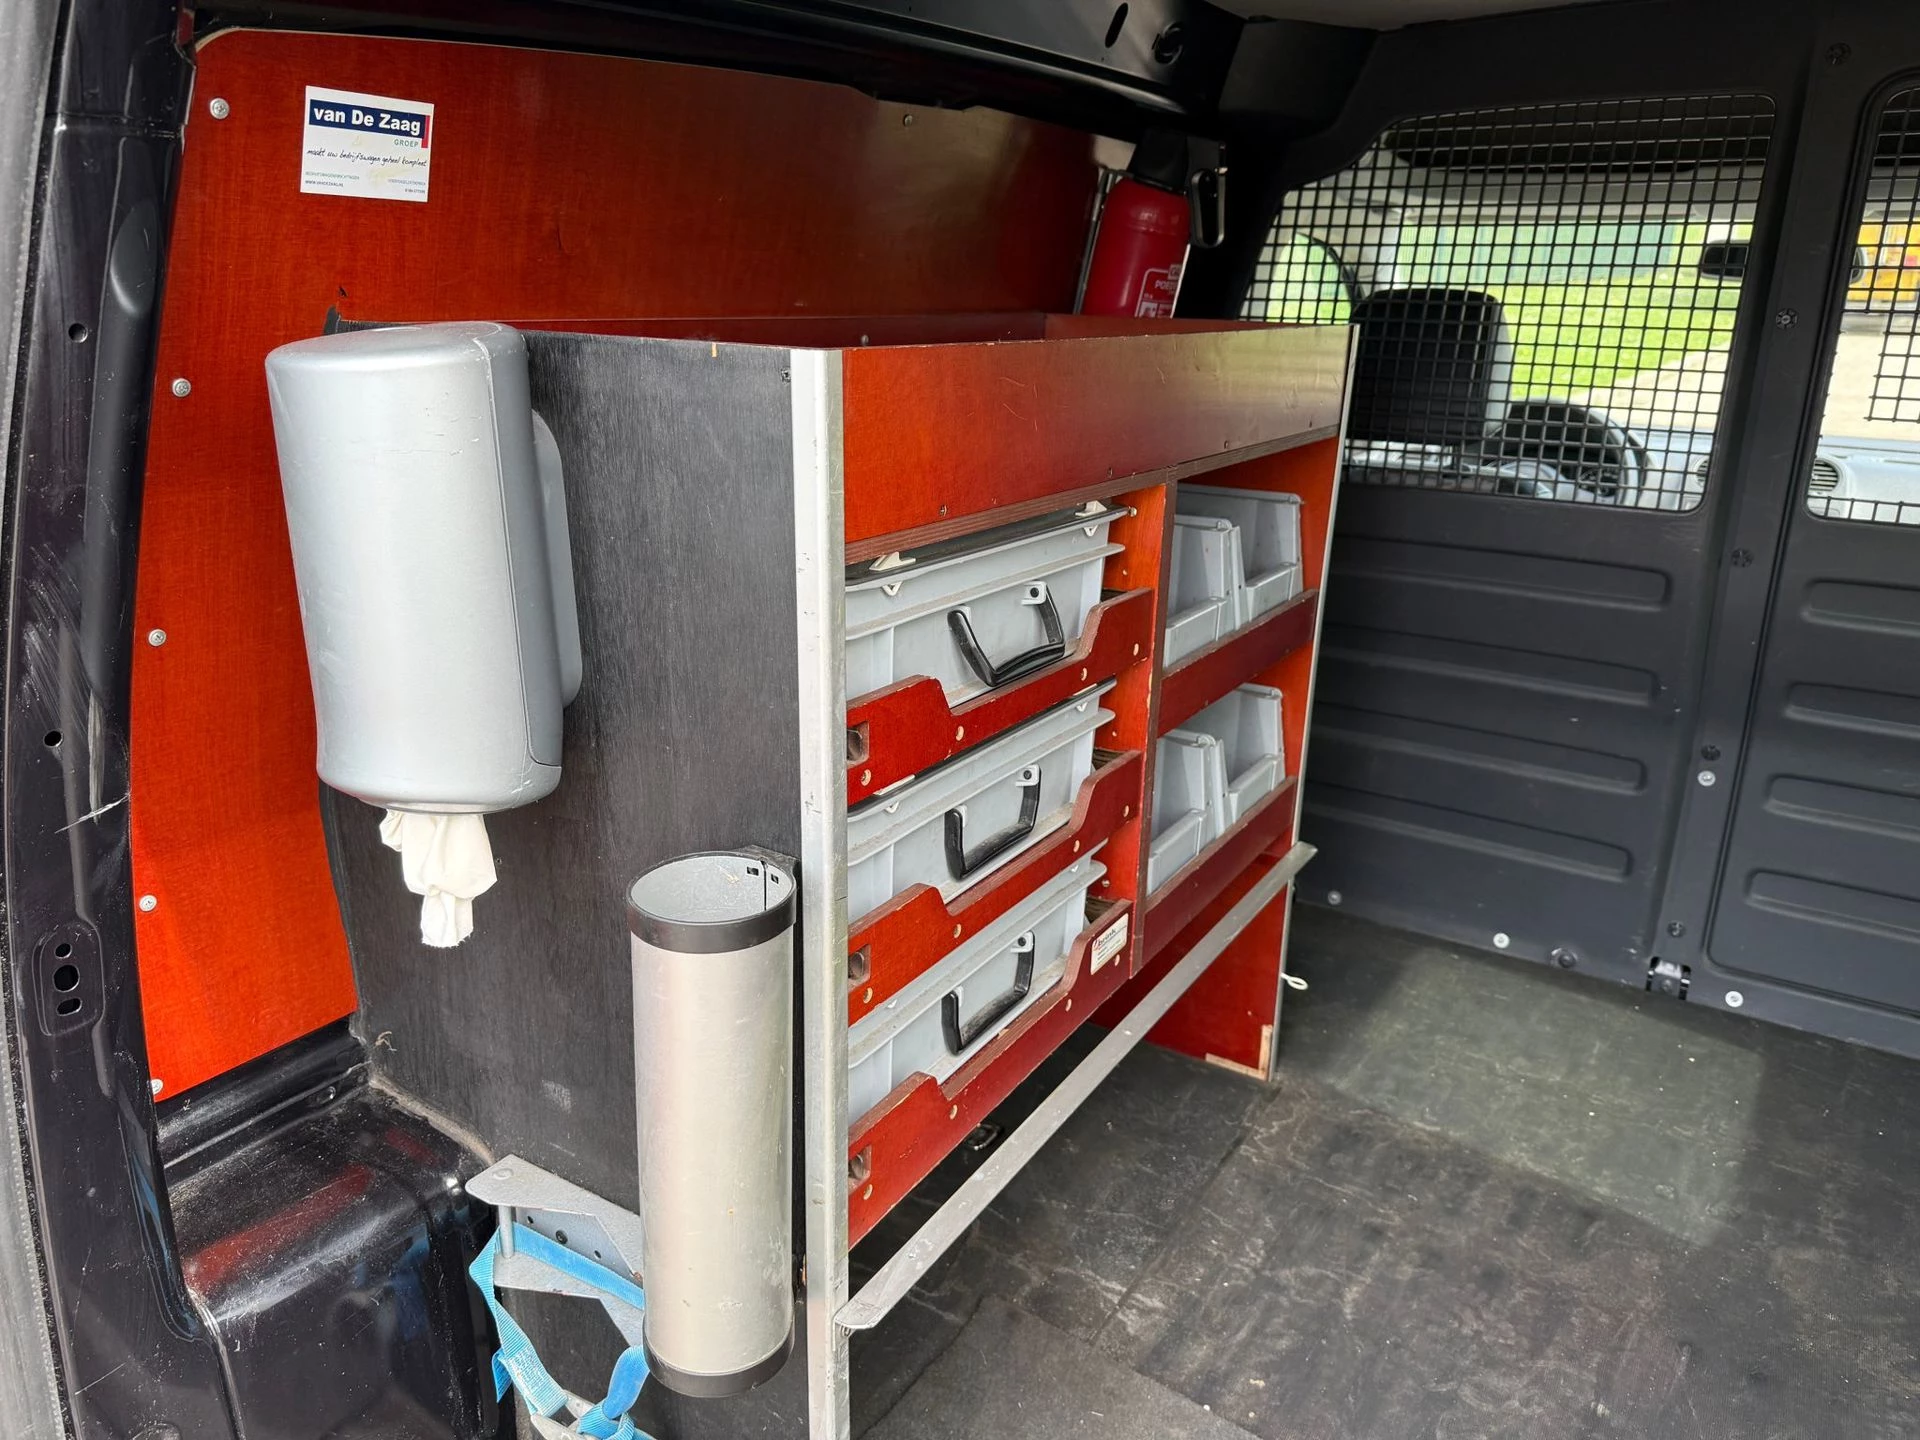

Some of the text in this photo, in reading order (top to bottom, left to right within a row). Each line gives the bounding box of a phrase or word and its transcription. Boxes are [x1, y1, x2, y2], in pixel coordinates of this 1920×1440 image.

[313, 107, 421, 136] van De Zaag
[394, 138, 419, 148] GROEP
[306, 147, 326, 156] maakt
[339, 150, 381, 165] bedrijfswagen
[382, 155, 400, 166] geheel
[401, 156, 427, 167] kompleet
